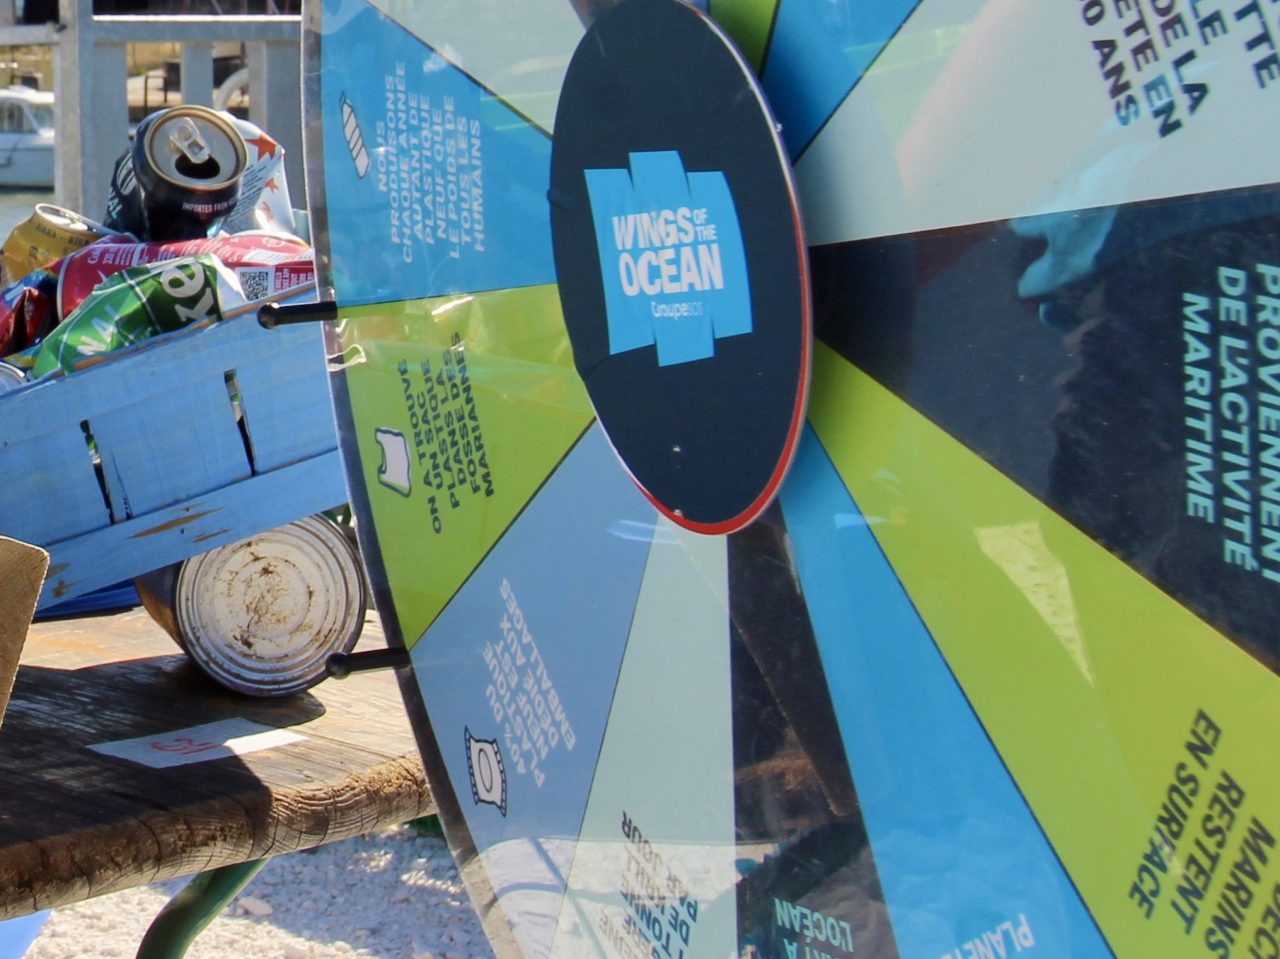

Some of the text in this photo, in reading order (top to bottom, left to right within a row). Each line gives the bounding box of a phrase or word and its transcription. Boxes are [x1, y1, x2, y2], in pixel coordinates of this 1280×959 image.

[1091, 38, 1142, 128] ANS
[1142, 73, 1183, 140] EN
[1172, 49, 1210, 117] LA
[376, 121, 388, 192] NOUS
[385, 75, 401, 244] PRODUISONS
[400, 156, 412, 263] CHAQUE
[408, 92, 423, 239] AUTANT DE
[420, 94, 435, 245] PLASTIQUE
[432, 107, 447, 239] NEUF QUE
[444, 95, 460, 259] LE POIDS DE
[457, 116, 472, 245] TOUS LES
[470, 119, 485, 252] HUMAINS
[612, 207, 708, 250] WINGS OF
[619, 243, 724, 296] OCEAN
[695, 224, 718, 241] THE
[417, 391, 444, 490] UN SAC
[421, 359, 460, 509] PLASTIQUE
[435, 368, 468, 486] DANS LA
[443, 349, 481, 494] FOSSE DES
[451, 331, 495, 498] MARIANNES
[1182, 292, 1215, 524] MARITIME
[1218, 266, 1259, 572] DE L'ACTIVITÉ
[423, 471, 433, 488] A
[427, 495, 442, 535] ON
[494, 639, 549, 761] NEUF EST
[499, 612, 527, 666] AUX
[500, 577, 577, 752] EMBALLAGES
[482, 641, 546, 789] PLASTIQUE
[485, 683, 527, 775] 40% DU
[621, 810, 662, 872] JOUR
[1128, 707, 1222, 920] EN SURFACE
[1170, 769, 1246, 936] RESTENT
[1205, 816, 1277, 959] MARINS
